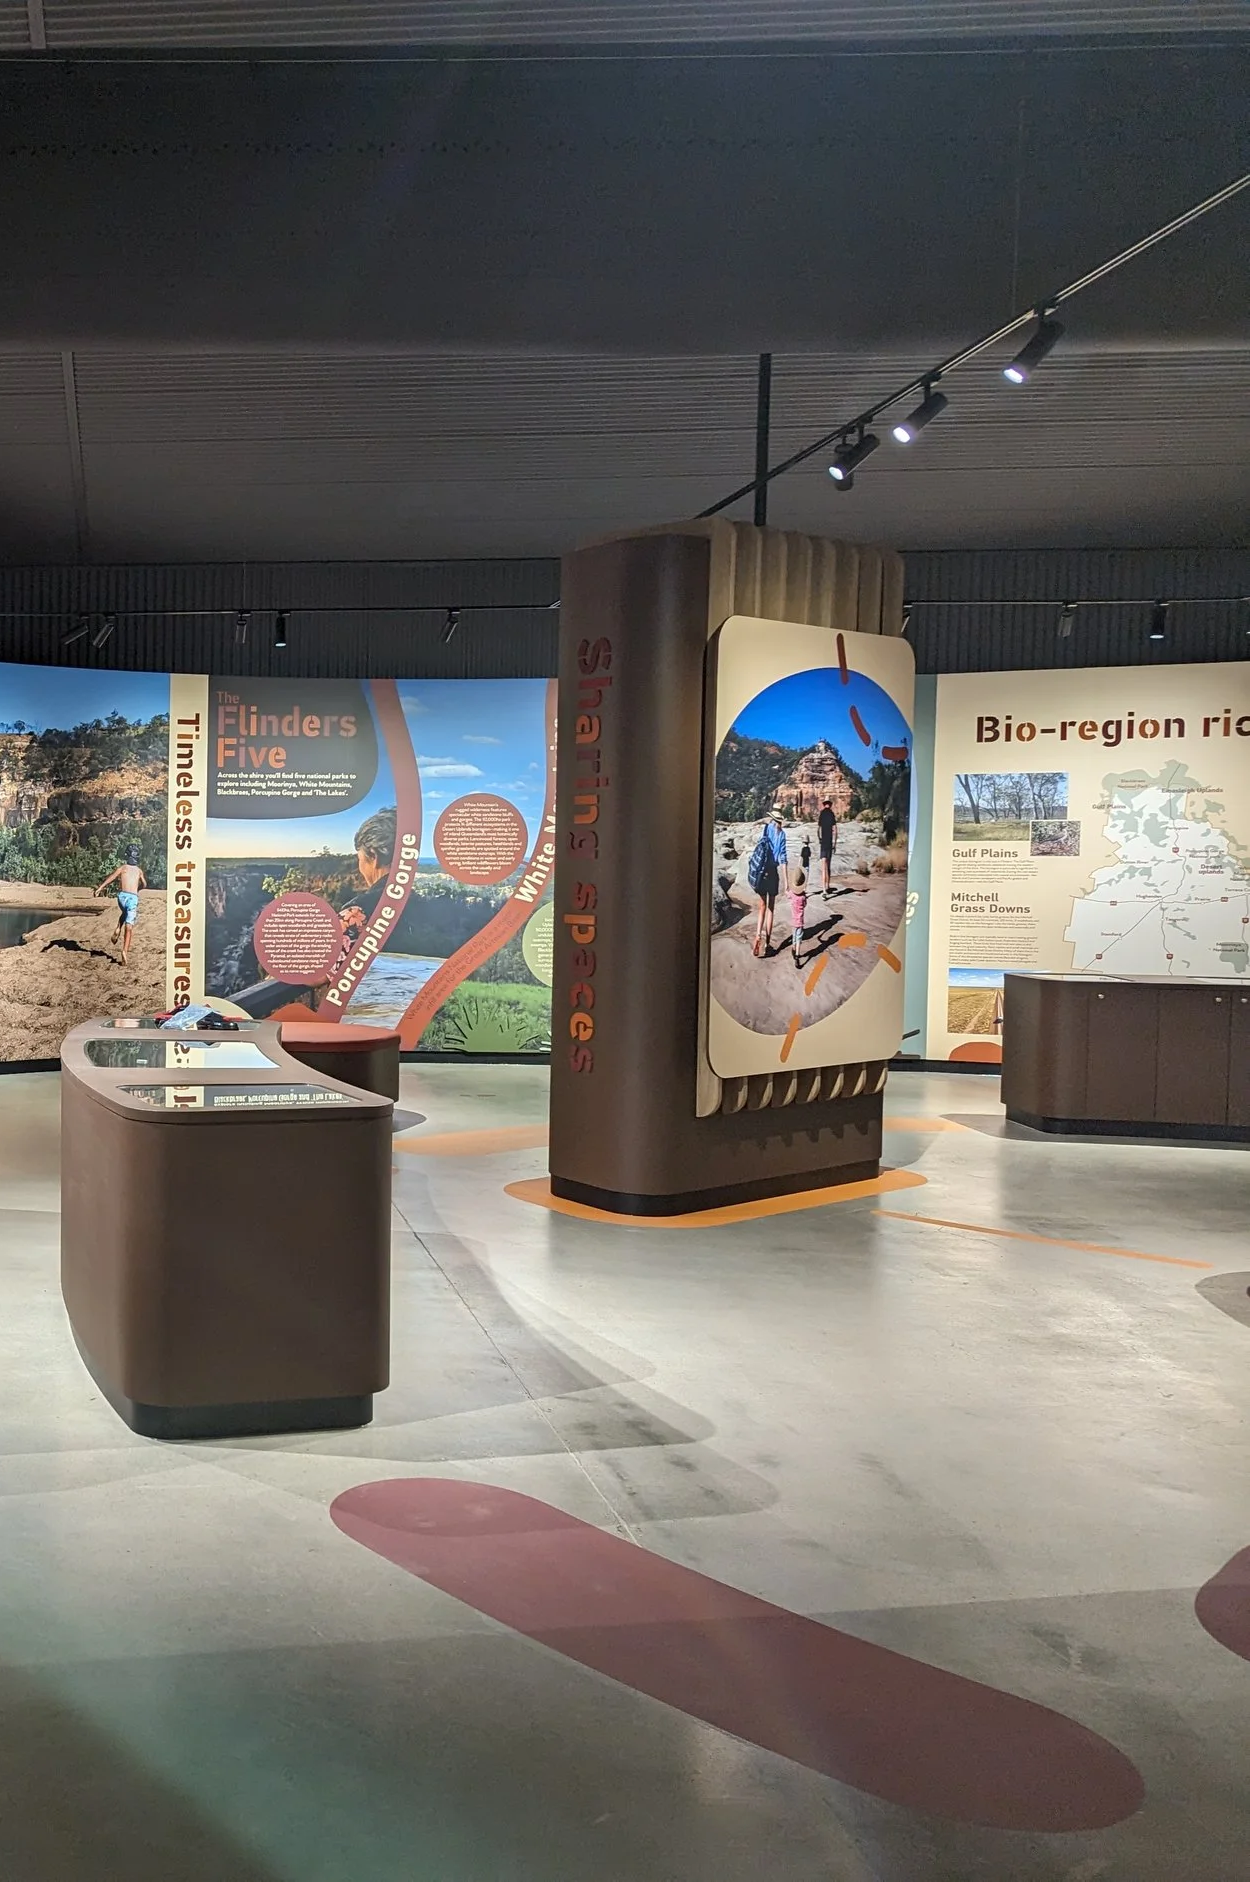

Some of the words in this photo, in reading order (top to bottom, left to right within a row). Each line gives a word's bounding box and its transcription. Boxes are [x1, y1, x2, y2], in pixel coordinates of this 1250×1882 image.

[217, 691, 240, 704] The
[218, 705, 357, 737] Flinders
[976, 711, 1185, 748] Bio-region
[217, 737, 287, 769] Five
[568, 636, 613, 860] Sharing
[175, 713, 201, 850] Timeless
[240, 780, 266, 789] including
[251, 789, 281, 797] Porcupine
[282, 790, 301, 798] Gorge
[952, 848, 978, 858] Gulf
[981, 848, 1018, 858] Plains
[514, 842, 556, 903] White
[950, 904, 985, 913] Grass
[989, 904, 1031, 914] Downs
[951, 893, 999, 902] Mitchell
[174, 861, 196, 1008] treasures
[326, 905, 396, 1006] Porcupine
[386, 833, 420, 900] Gorge
[563, 881, 598, 1074] spaces
